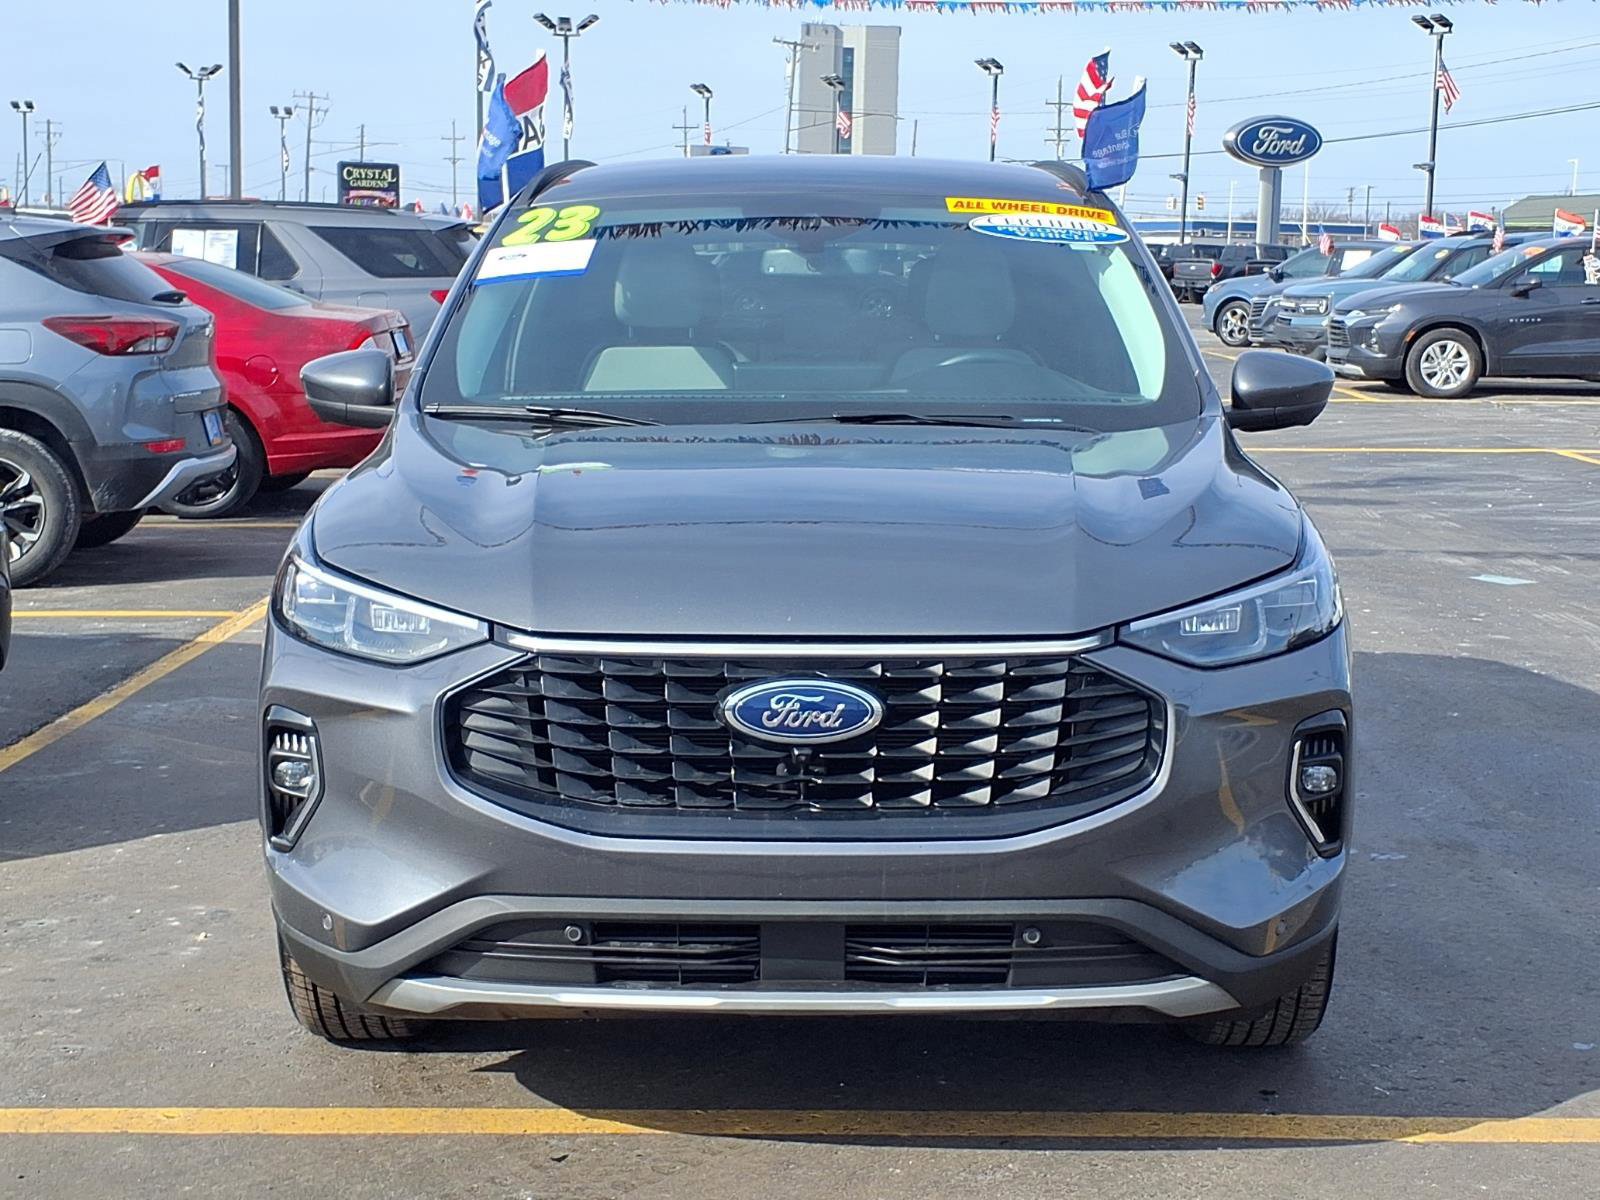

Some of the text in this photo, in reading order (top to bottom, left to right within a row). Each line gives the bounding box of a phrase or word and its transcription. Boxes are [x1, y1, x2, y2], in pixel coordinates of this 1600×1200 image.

[1253, 126, 1306, 155] Ford
[343, 166, 396, 182] CRYSTAL
[350, 179, 388, 188] GARDENS
[953, 200, 1106, 220] ALL WHEEL DRIVE
[502, 205, 600, 247] 23
[761, 693, 846, 728] Ford
